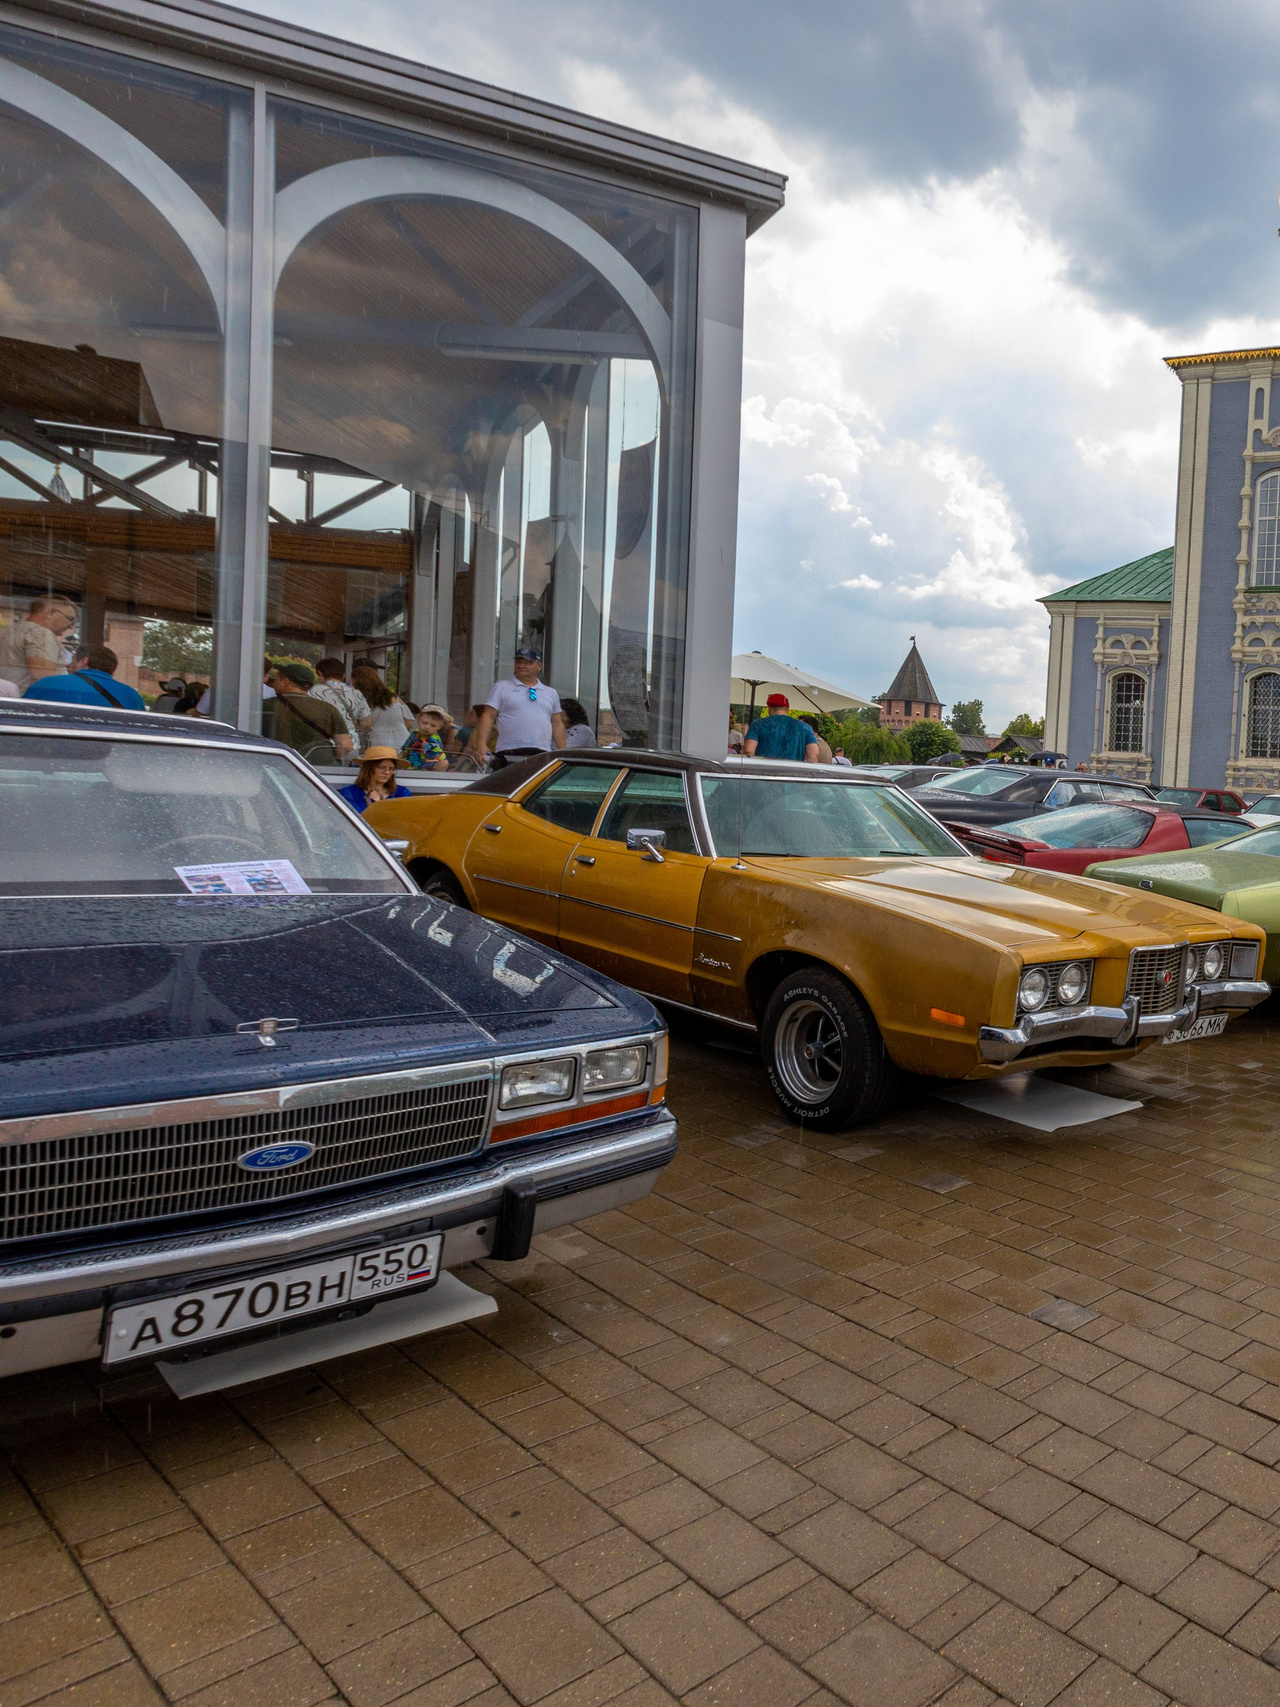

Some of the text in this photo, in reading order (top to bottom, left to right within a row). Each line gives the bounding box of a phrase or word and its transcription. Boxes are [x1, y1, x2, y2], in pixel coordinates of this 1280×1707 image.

[783, 987, 849, 1038] ASHLEY'S GARAGE
[767, 1066, 830, 1118] DETROIT MUSCLE
[257, 1148, 299, 1166] Ford
[356, 1243, 429, 1283] 550
[371, 1273, 405, 1291] RUS
